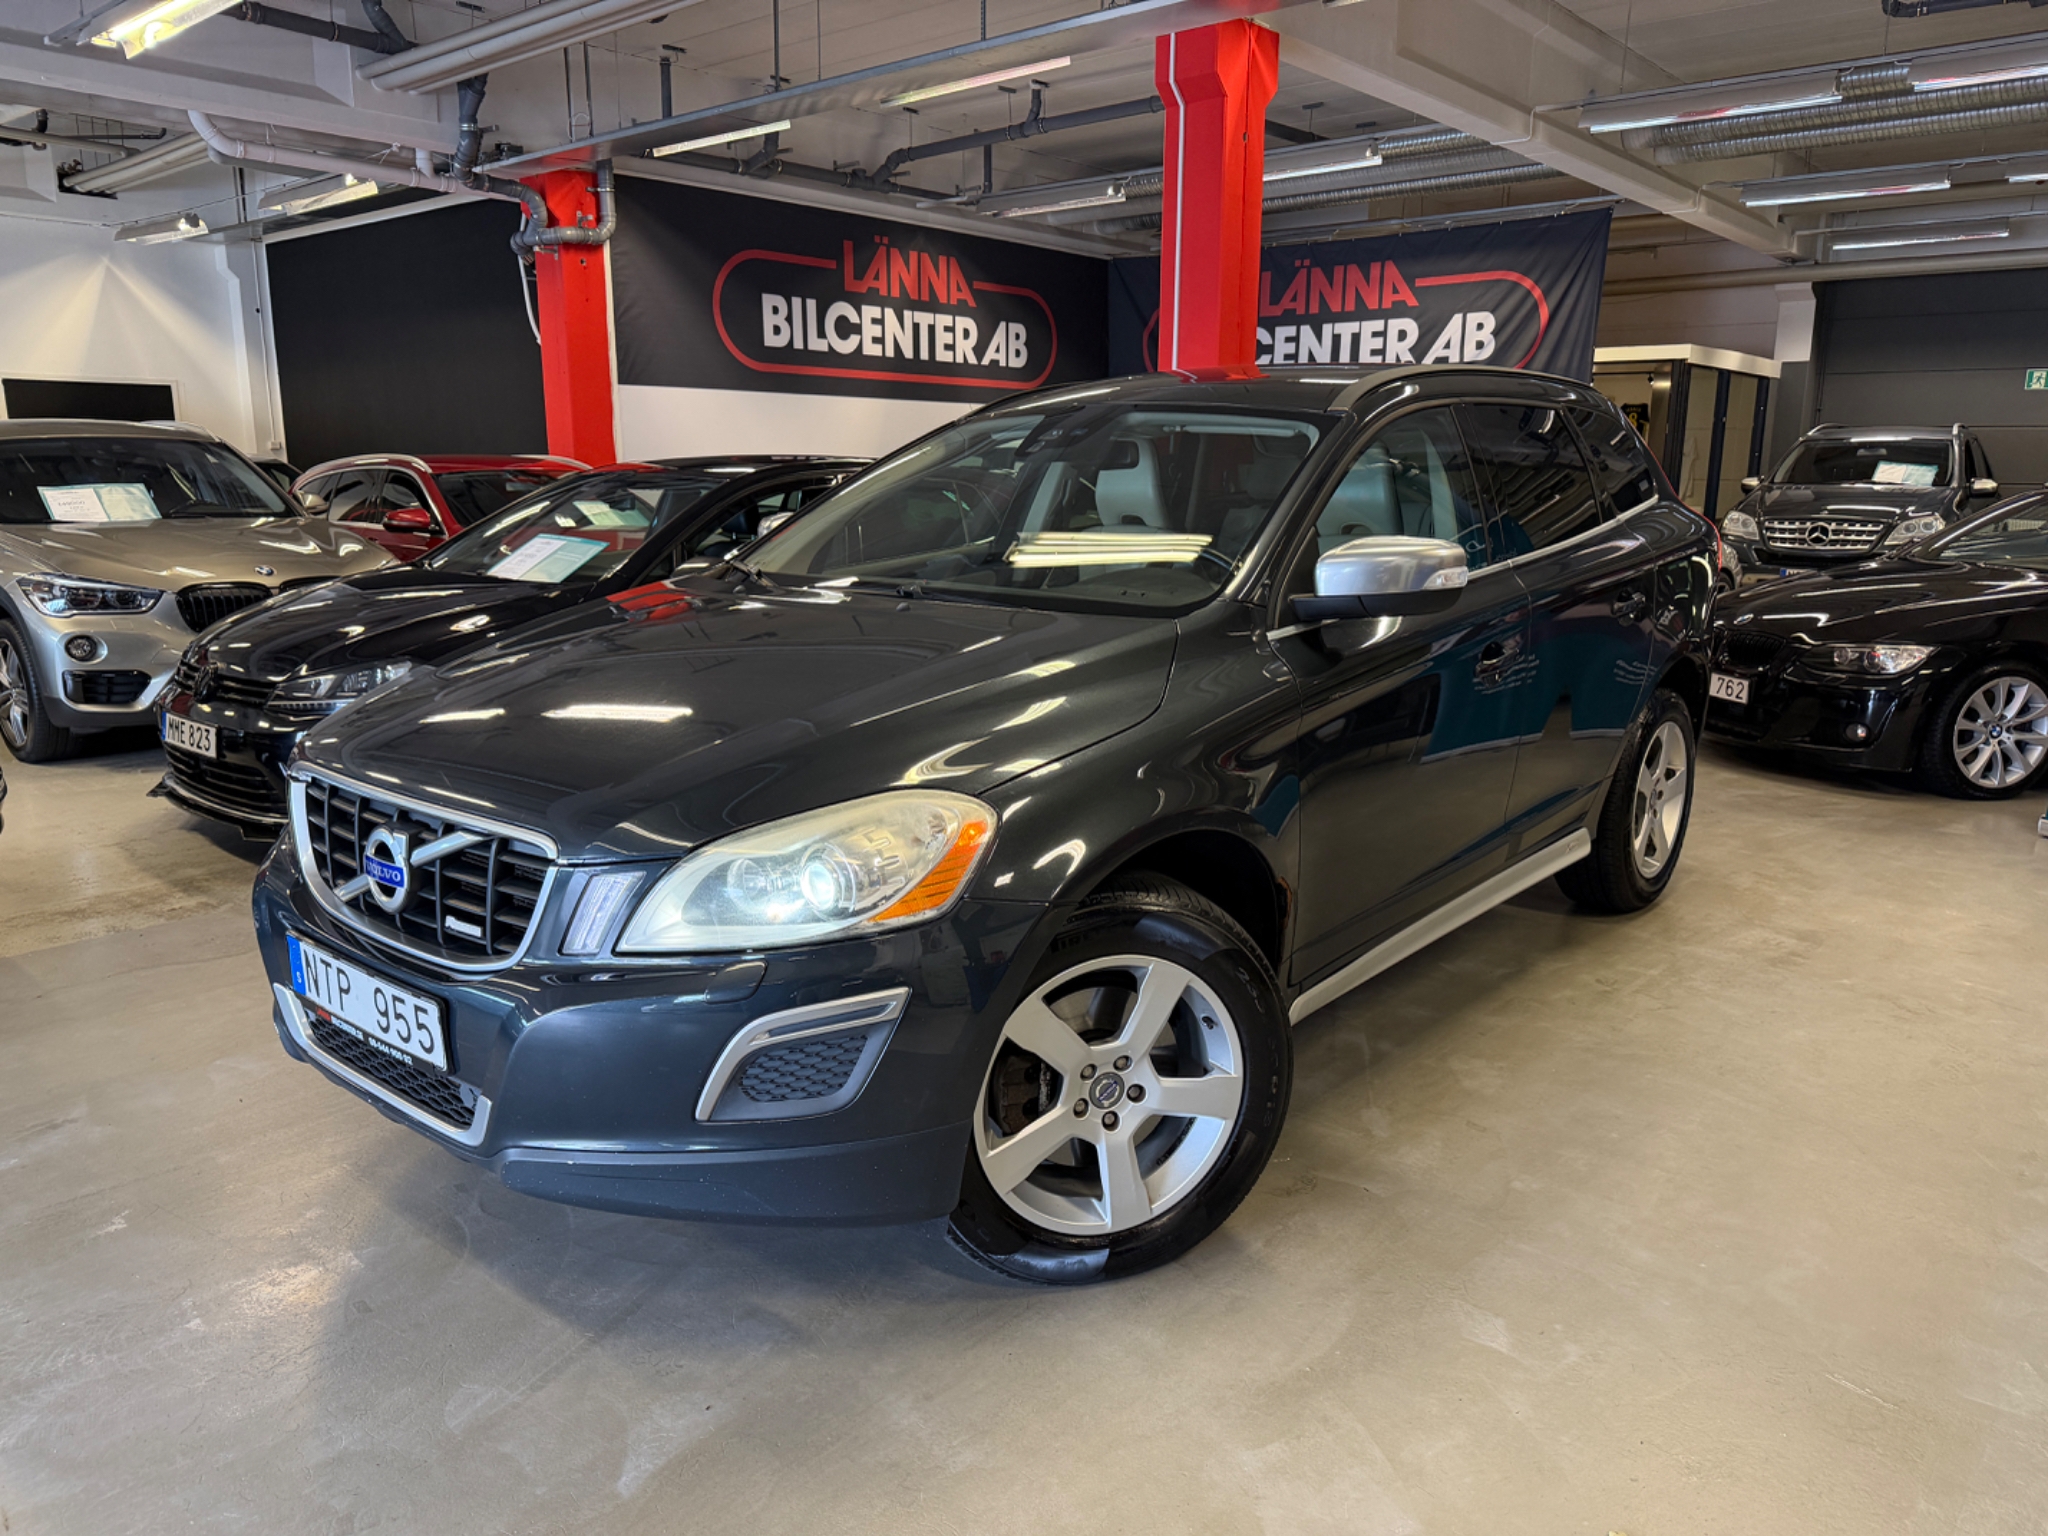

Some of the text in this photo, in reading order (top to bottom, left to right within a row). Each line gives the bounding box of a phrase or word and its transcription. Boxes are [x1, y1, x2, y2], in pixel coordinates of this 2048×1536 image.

[843, 235, 977, 308] LÄNNA
[1259, 259, 1419, 317] LÄNNA
[761, 293, 1028, 368] BILCENTER AB
[1421, 311, 1496, 365] AB
[1716, 677, 1745, 700] 762
[189, 724, 211, 752] 823
[366, 859, 401, 883] VOLVO
[303, 949, 351, 1012] NTP
[373, 987, 435, 1055] 955
